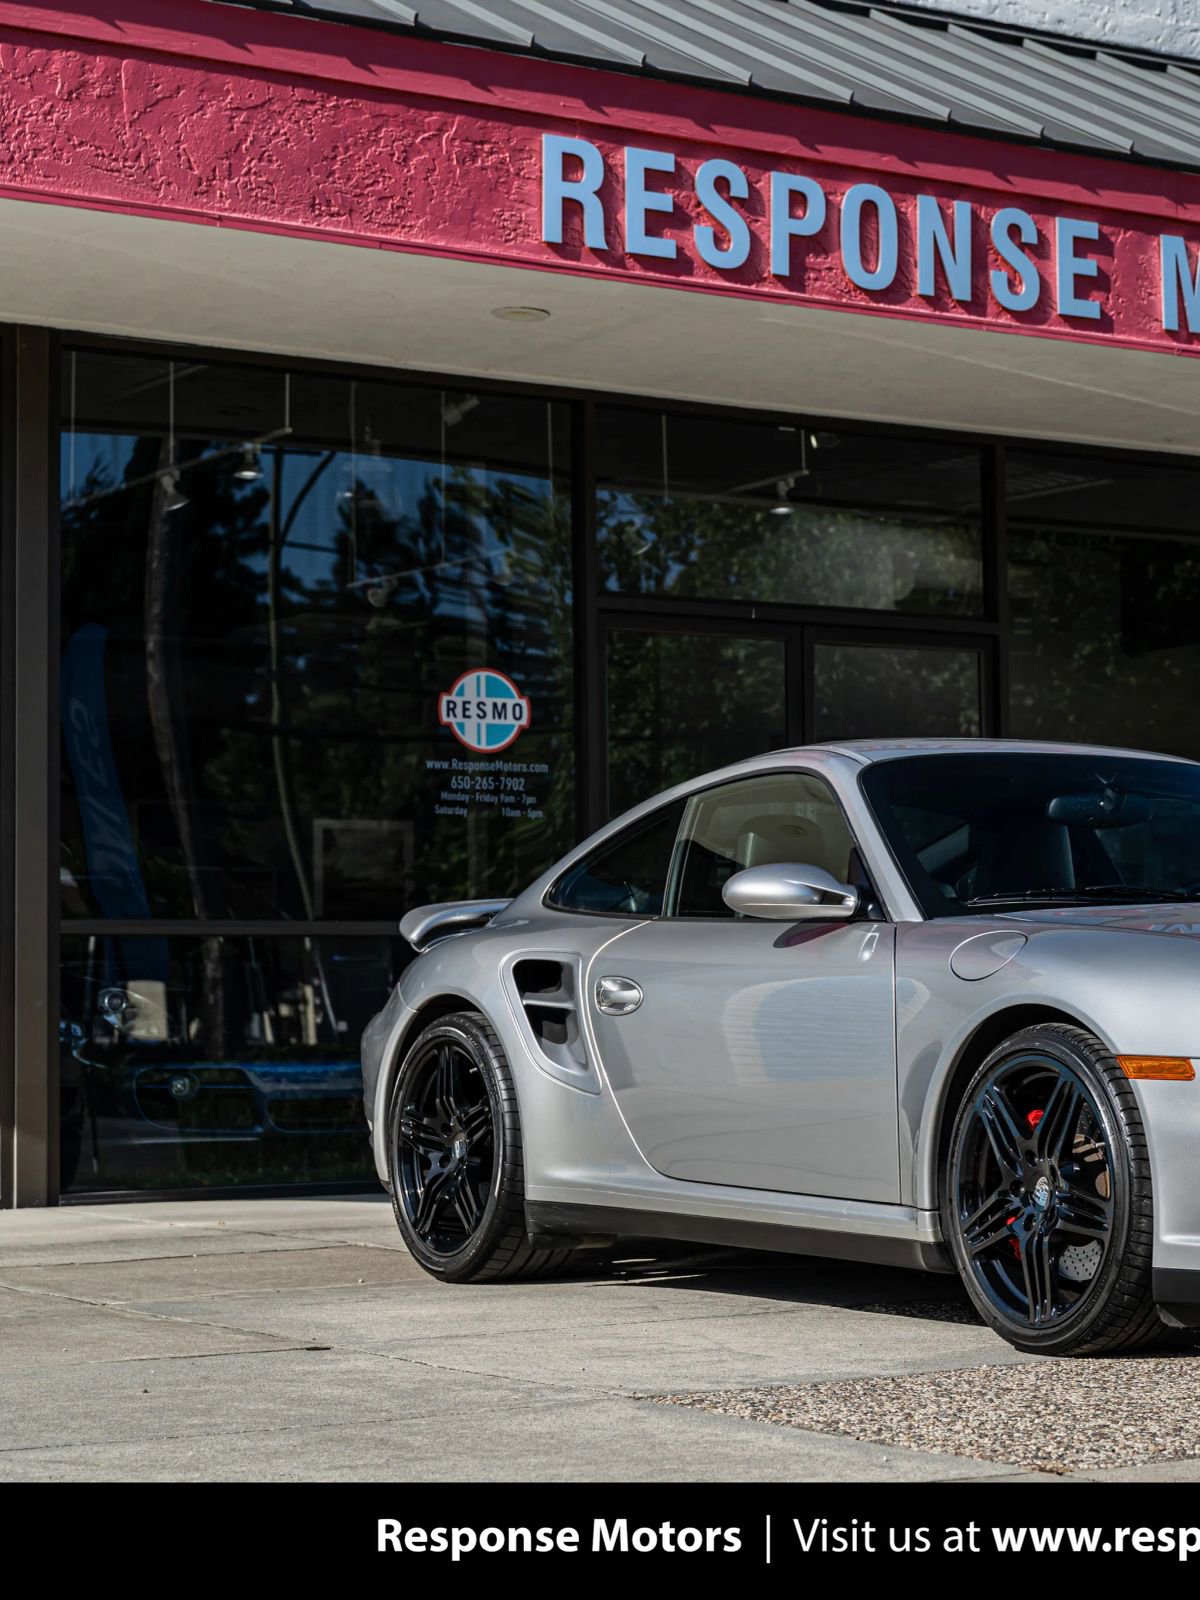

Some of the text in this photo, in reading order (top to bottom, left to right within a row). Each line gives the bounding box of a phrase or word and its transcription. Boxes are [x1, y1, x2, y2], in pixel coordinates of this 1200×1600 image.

[541, 133, 1101, 320] RESPONSE
[446, 700, 523, 721] RESMO
[425, 758, 549, 774] www.ResponseMotors.com
[450, 776, 526, 791] 650-265-7902
[440, 792, 469, 803] Monday
[475, 793, 499, 805] Friday
[500, 793, 515, 803] 9am
[522, 794, 537, 805] 7pm
[434, 805, 468, 817] Saturday
[501, 807, 521, 817] 10am
[527, 807, 544, 819] 5pm
